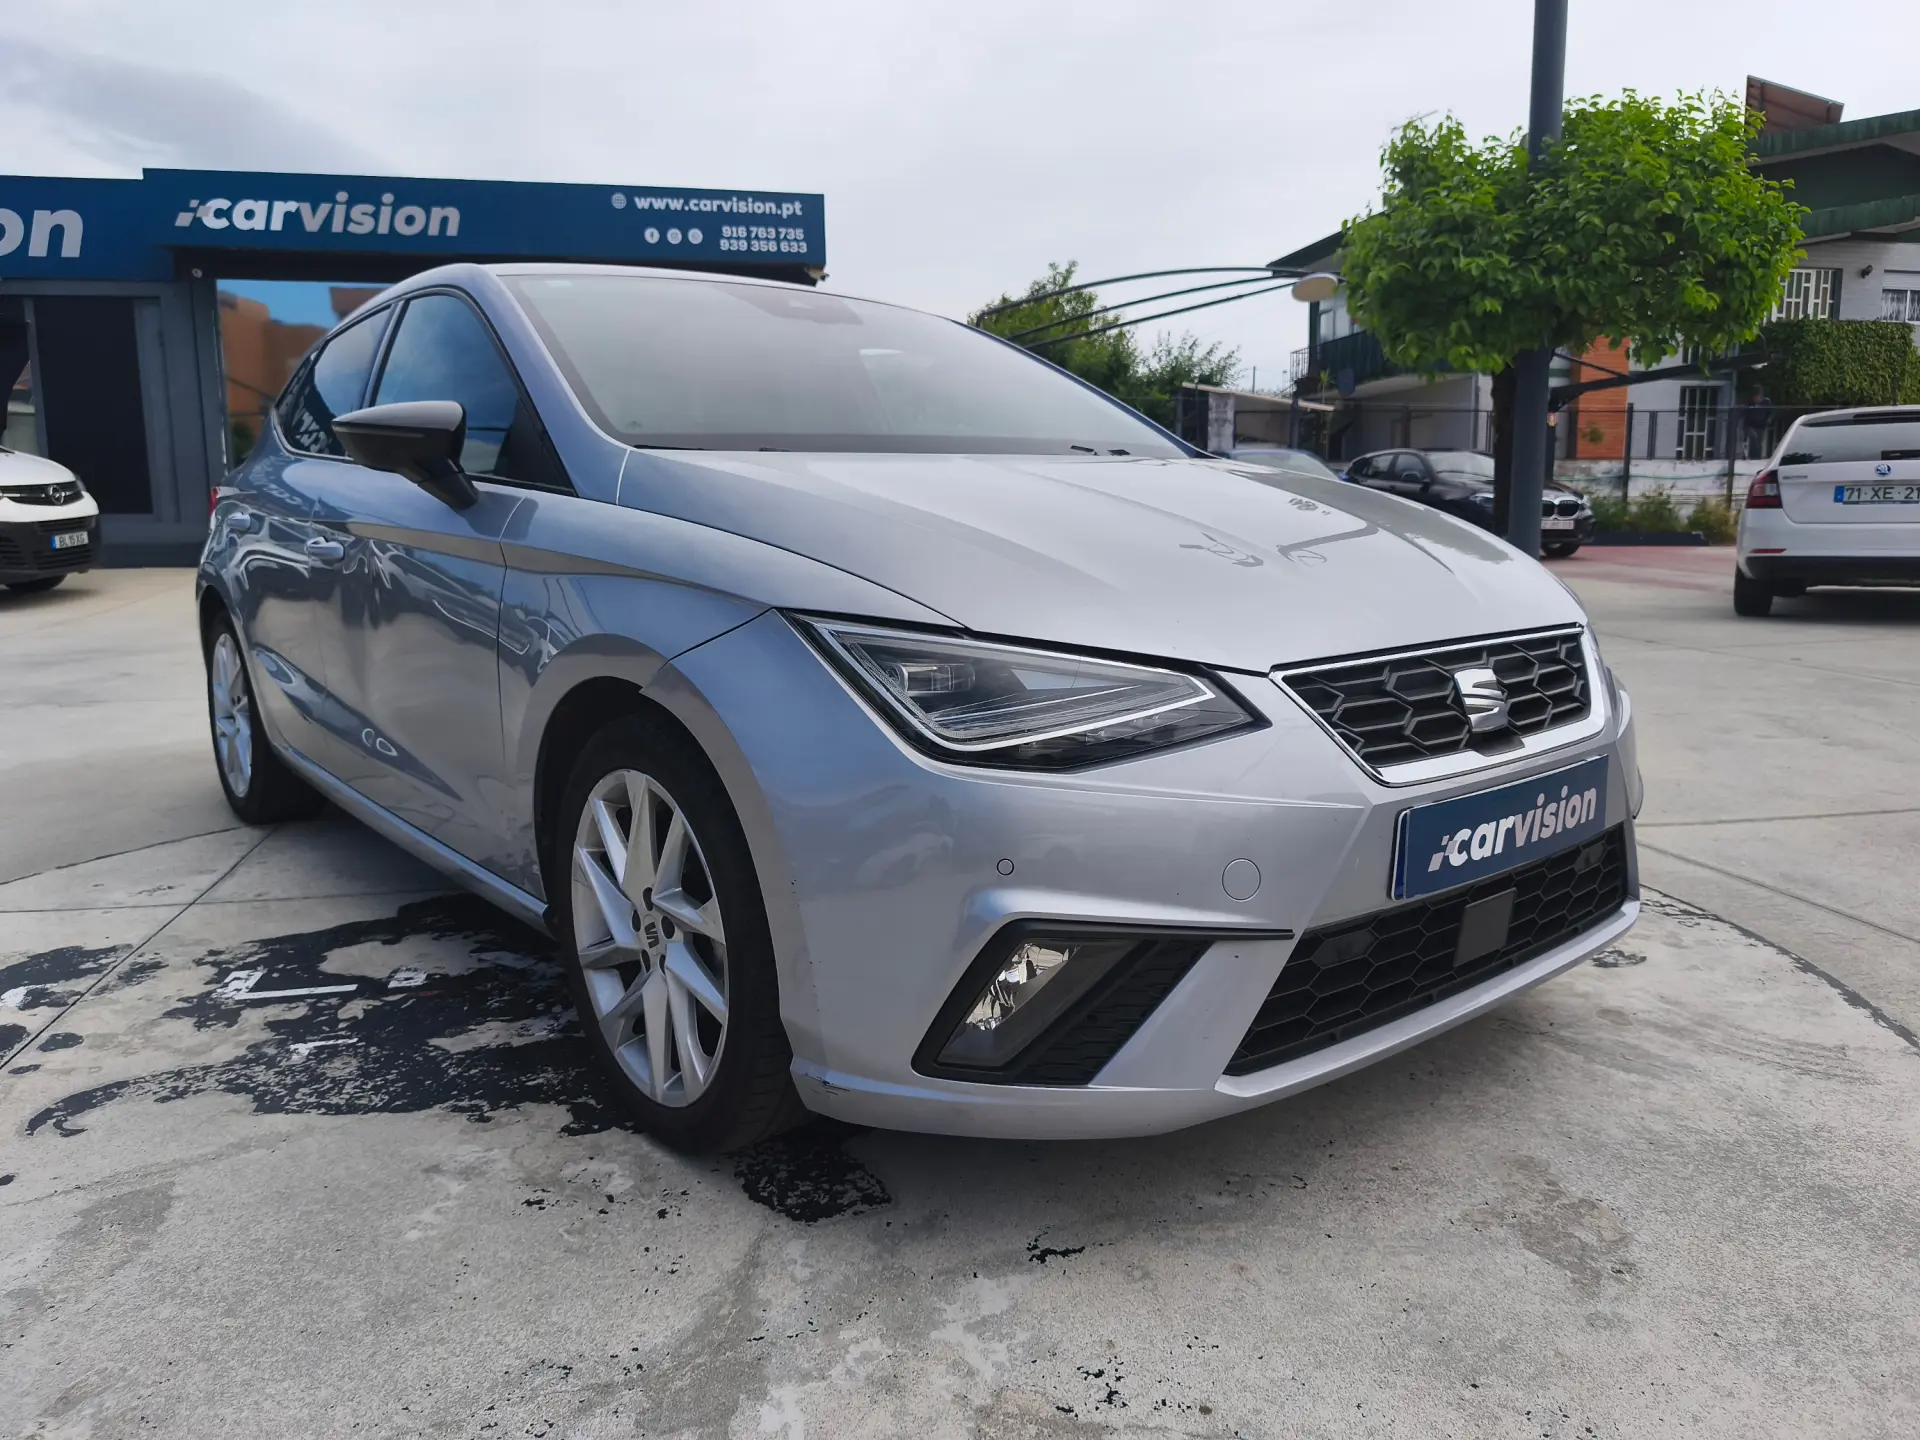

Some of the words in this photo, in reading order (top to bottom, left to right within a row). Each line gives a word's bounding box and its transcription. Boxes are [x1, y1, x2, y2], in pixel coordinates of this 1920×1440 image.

[200, 191, 461, 236] carvision
[634, 196, 803, 218] www.carvision.pt
[721, 226, 747, 238] 916
[778, 228, 804, 240] 735
[720, 239, 748, 251] 939
[750, 240, 777, 252] 356
[780, 241, 807, 253] 633
[1448, 785, 1597, 867] carvision
